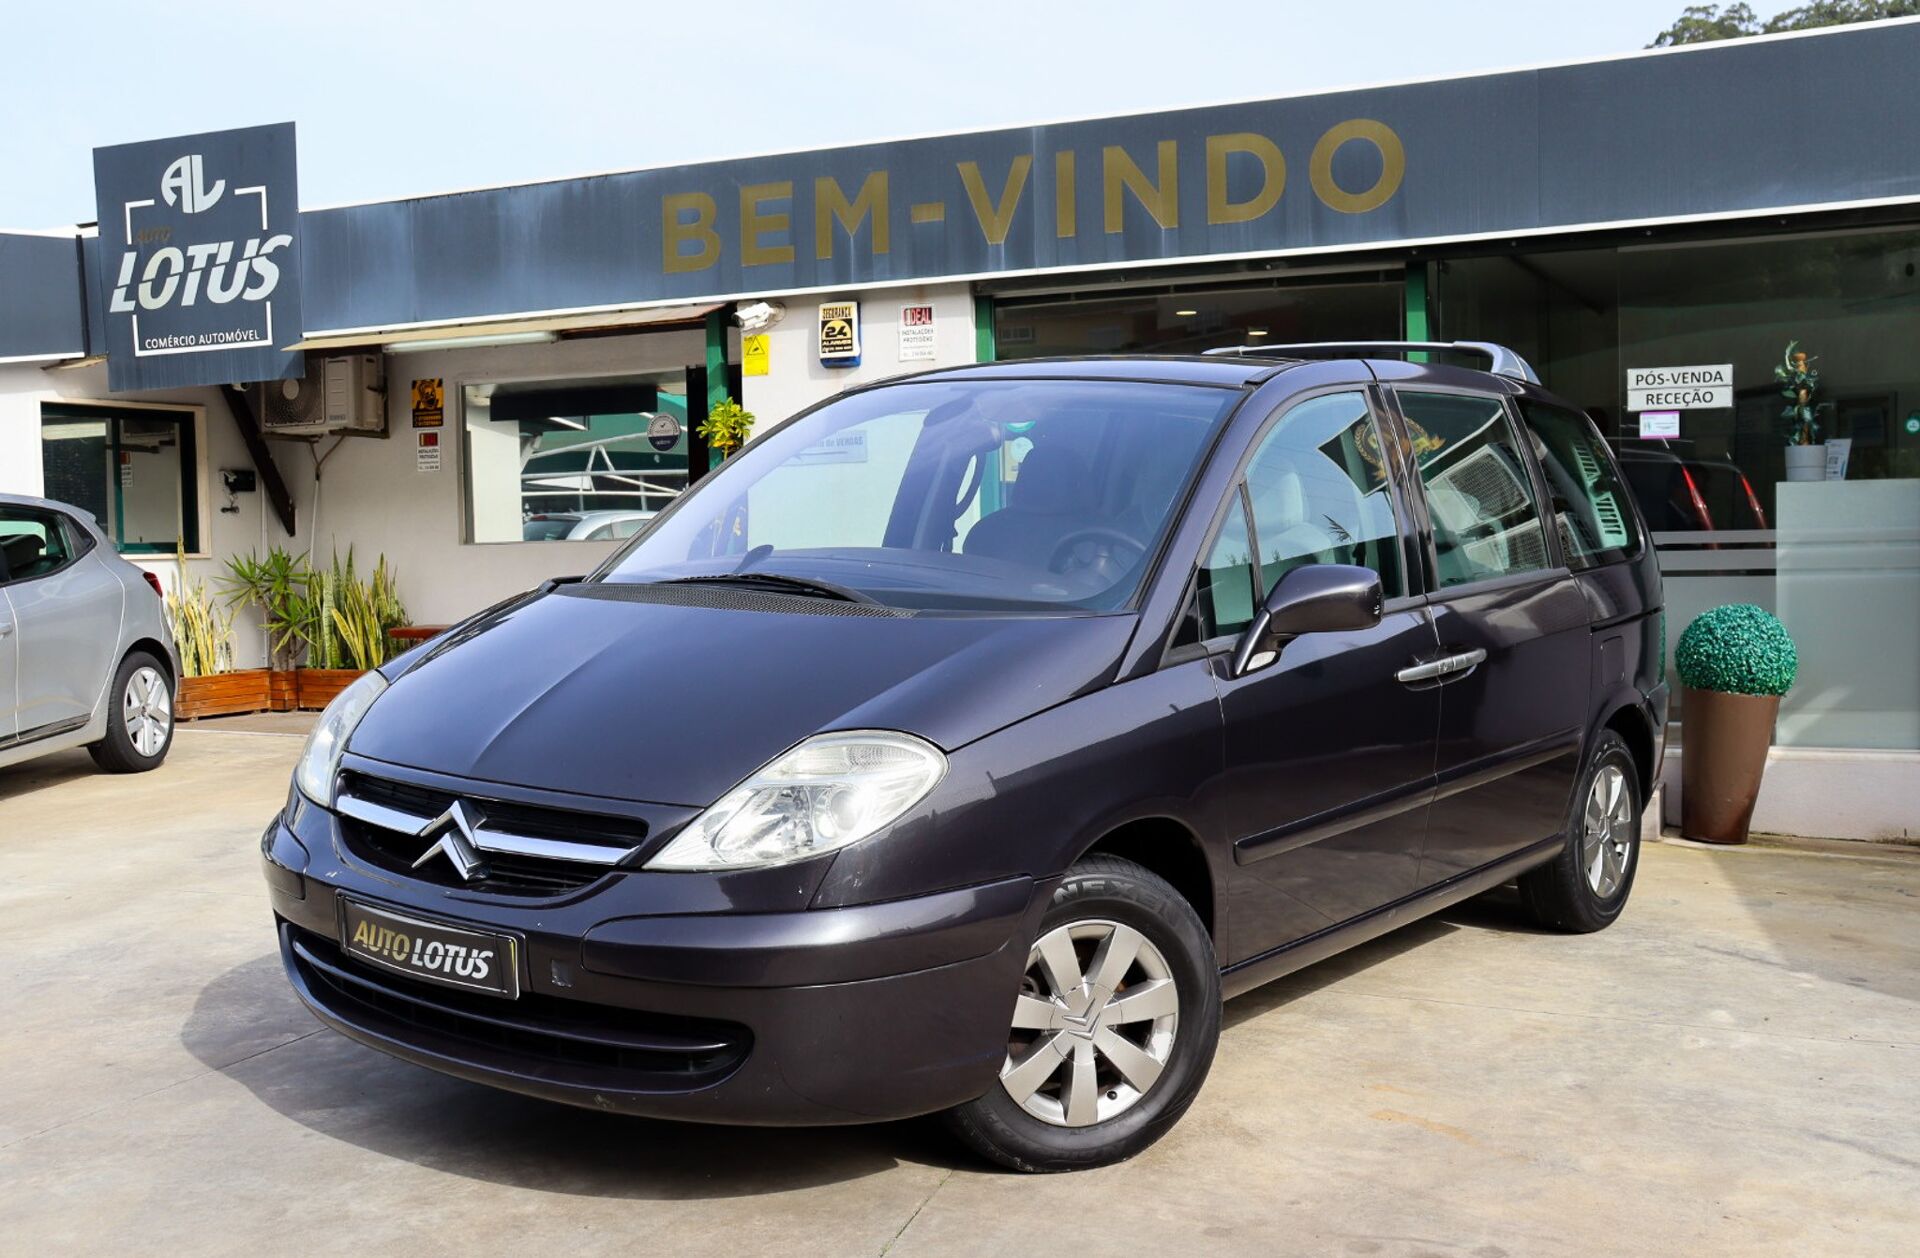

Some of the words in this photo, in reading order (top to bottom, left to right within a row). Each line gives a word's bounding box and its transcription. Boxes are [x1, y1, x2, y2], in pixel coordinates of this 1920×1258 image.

[662, 118, 1405, 273] BEM-VINDO
[109, 234, 293, 313] LOTUS
[145, 334, 196, 349] COMÉRCIO
[198, 328, 260, 344] AUTOMÓVEL
[824, 326, 847, 338] 24
[1635, 370, 1724, 386] PÓS-VENDA
[1645, 388, 1714, 407] RECEÇÃO
[353, 920, 411, 961] AUTO
[411, 938, 494, 980] LOTUS
